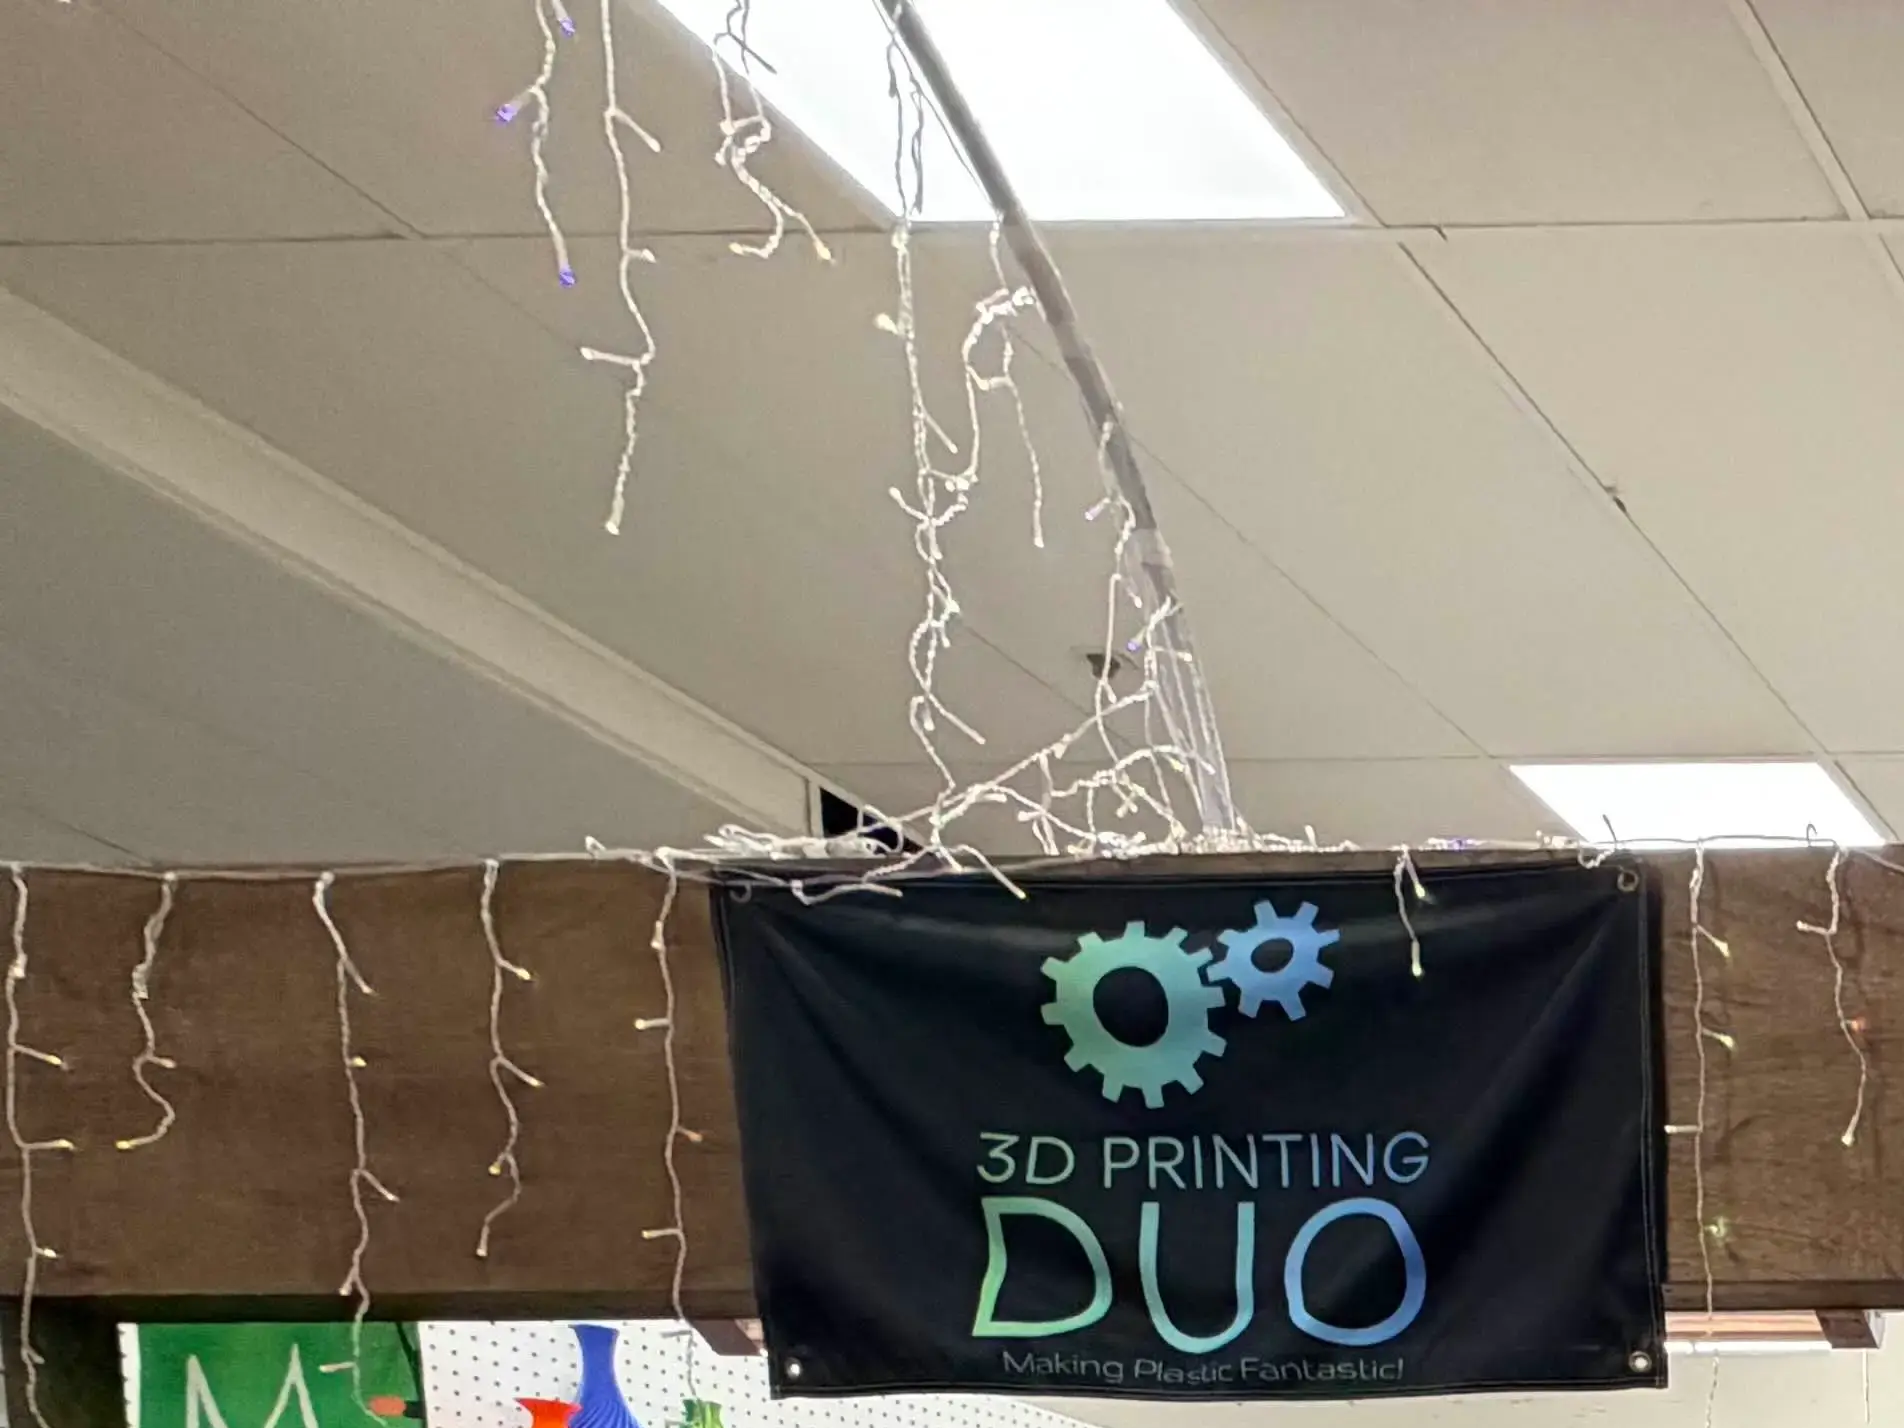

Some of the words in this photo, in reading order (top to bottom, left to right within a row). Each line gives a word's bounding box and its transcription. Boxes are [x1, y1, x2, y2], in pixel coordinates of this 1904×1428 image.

[978, 1132, 1076, 1185] 3D
[1103, 1130, 1430, 1189] PRINTING
[971, 1196, 1427, 1353] DUO
[1003, 1351, 1124, 1384] Making
[1133, 1358, 1234, 1386] Plastic
[1239, 1356, 1404, 1381] Fantastic!
